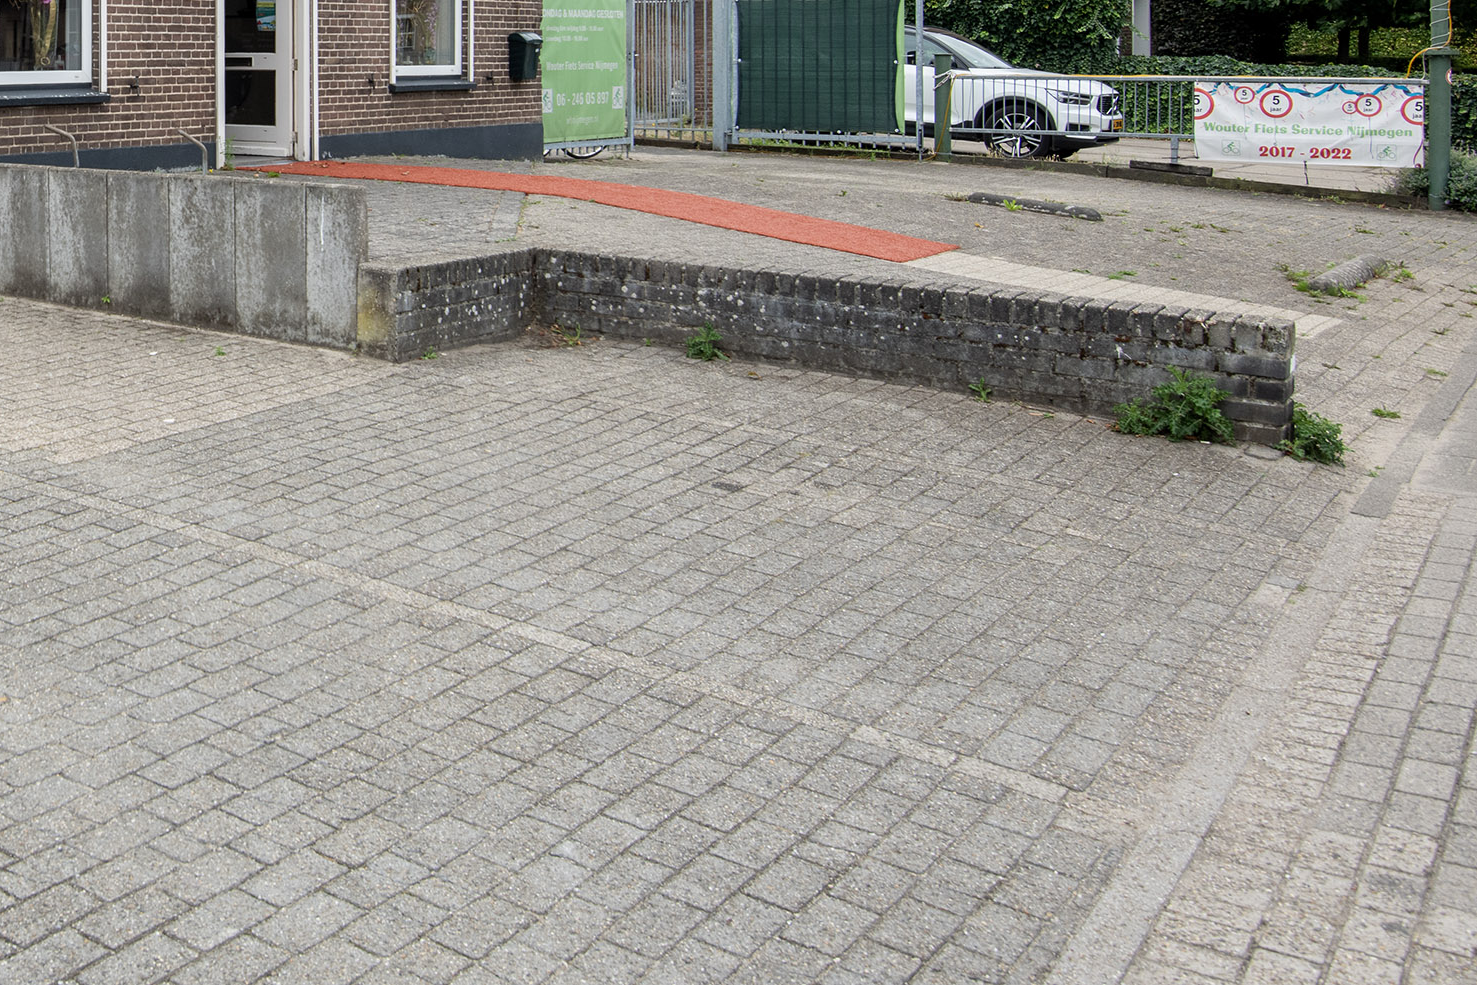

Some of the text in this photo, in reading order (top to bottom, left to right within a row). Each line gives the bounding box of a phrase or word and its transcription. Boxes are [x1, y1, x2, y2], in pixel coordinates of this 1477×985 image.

[542, 9, 562, 18] ONDAG
[557, 93, 566, 106] 06
[571, 92, 584, 105] 246
[586, 92, 595, 105] 05
[597, 91, 609, 104] 897
[1272, 95, 1280, 105] 5
[1365, 99, 1372, 107] 5
[1415, 101, 1423, 112] 5
[1204, 122, 1412, 138] Wouter Fiets Service Nijmegen
[1259, 145, 1295, 158] 2017
[1309, 147, 1352, 159] 2022
